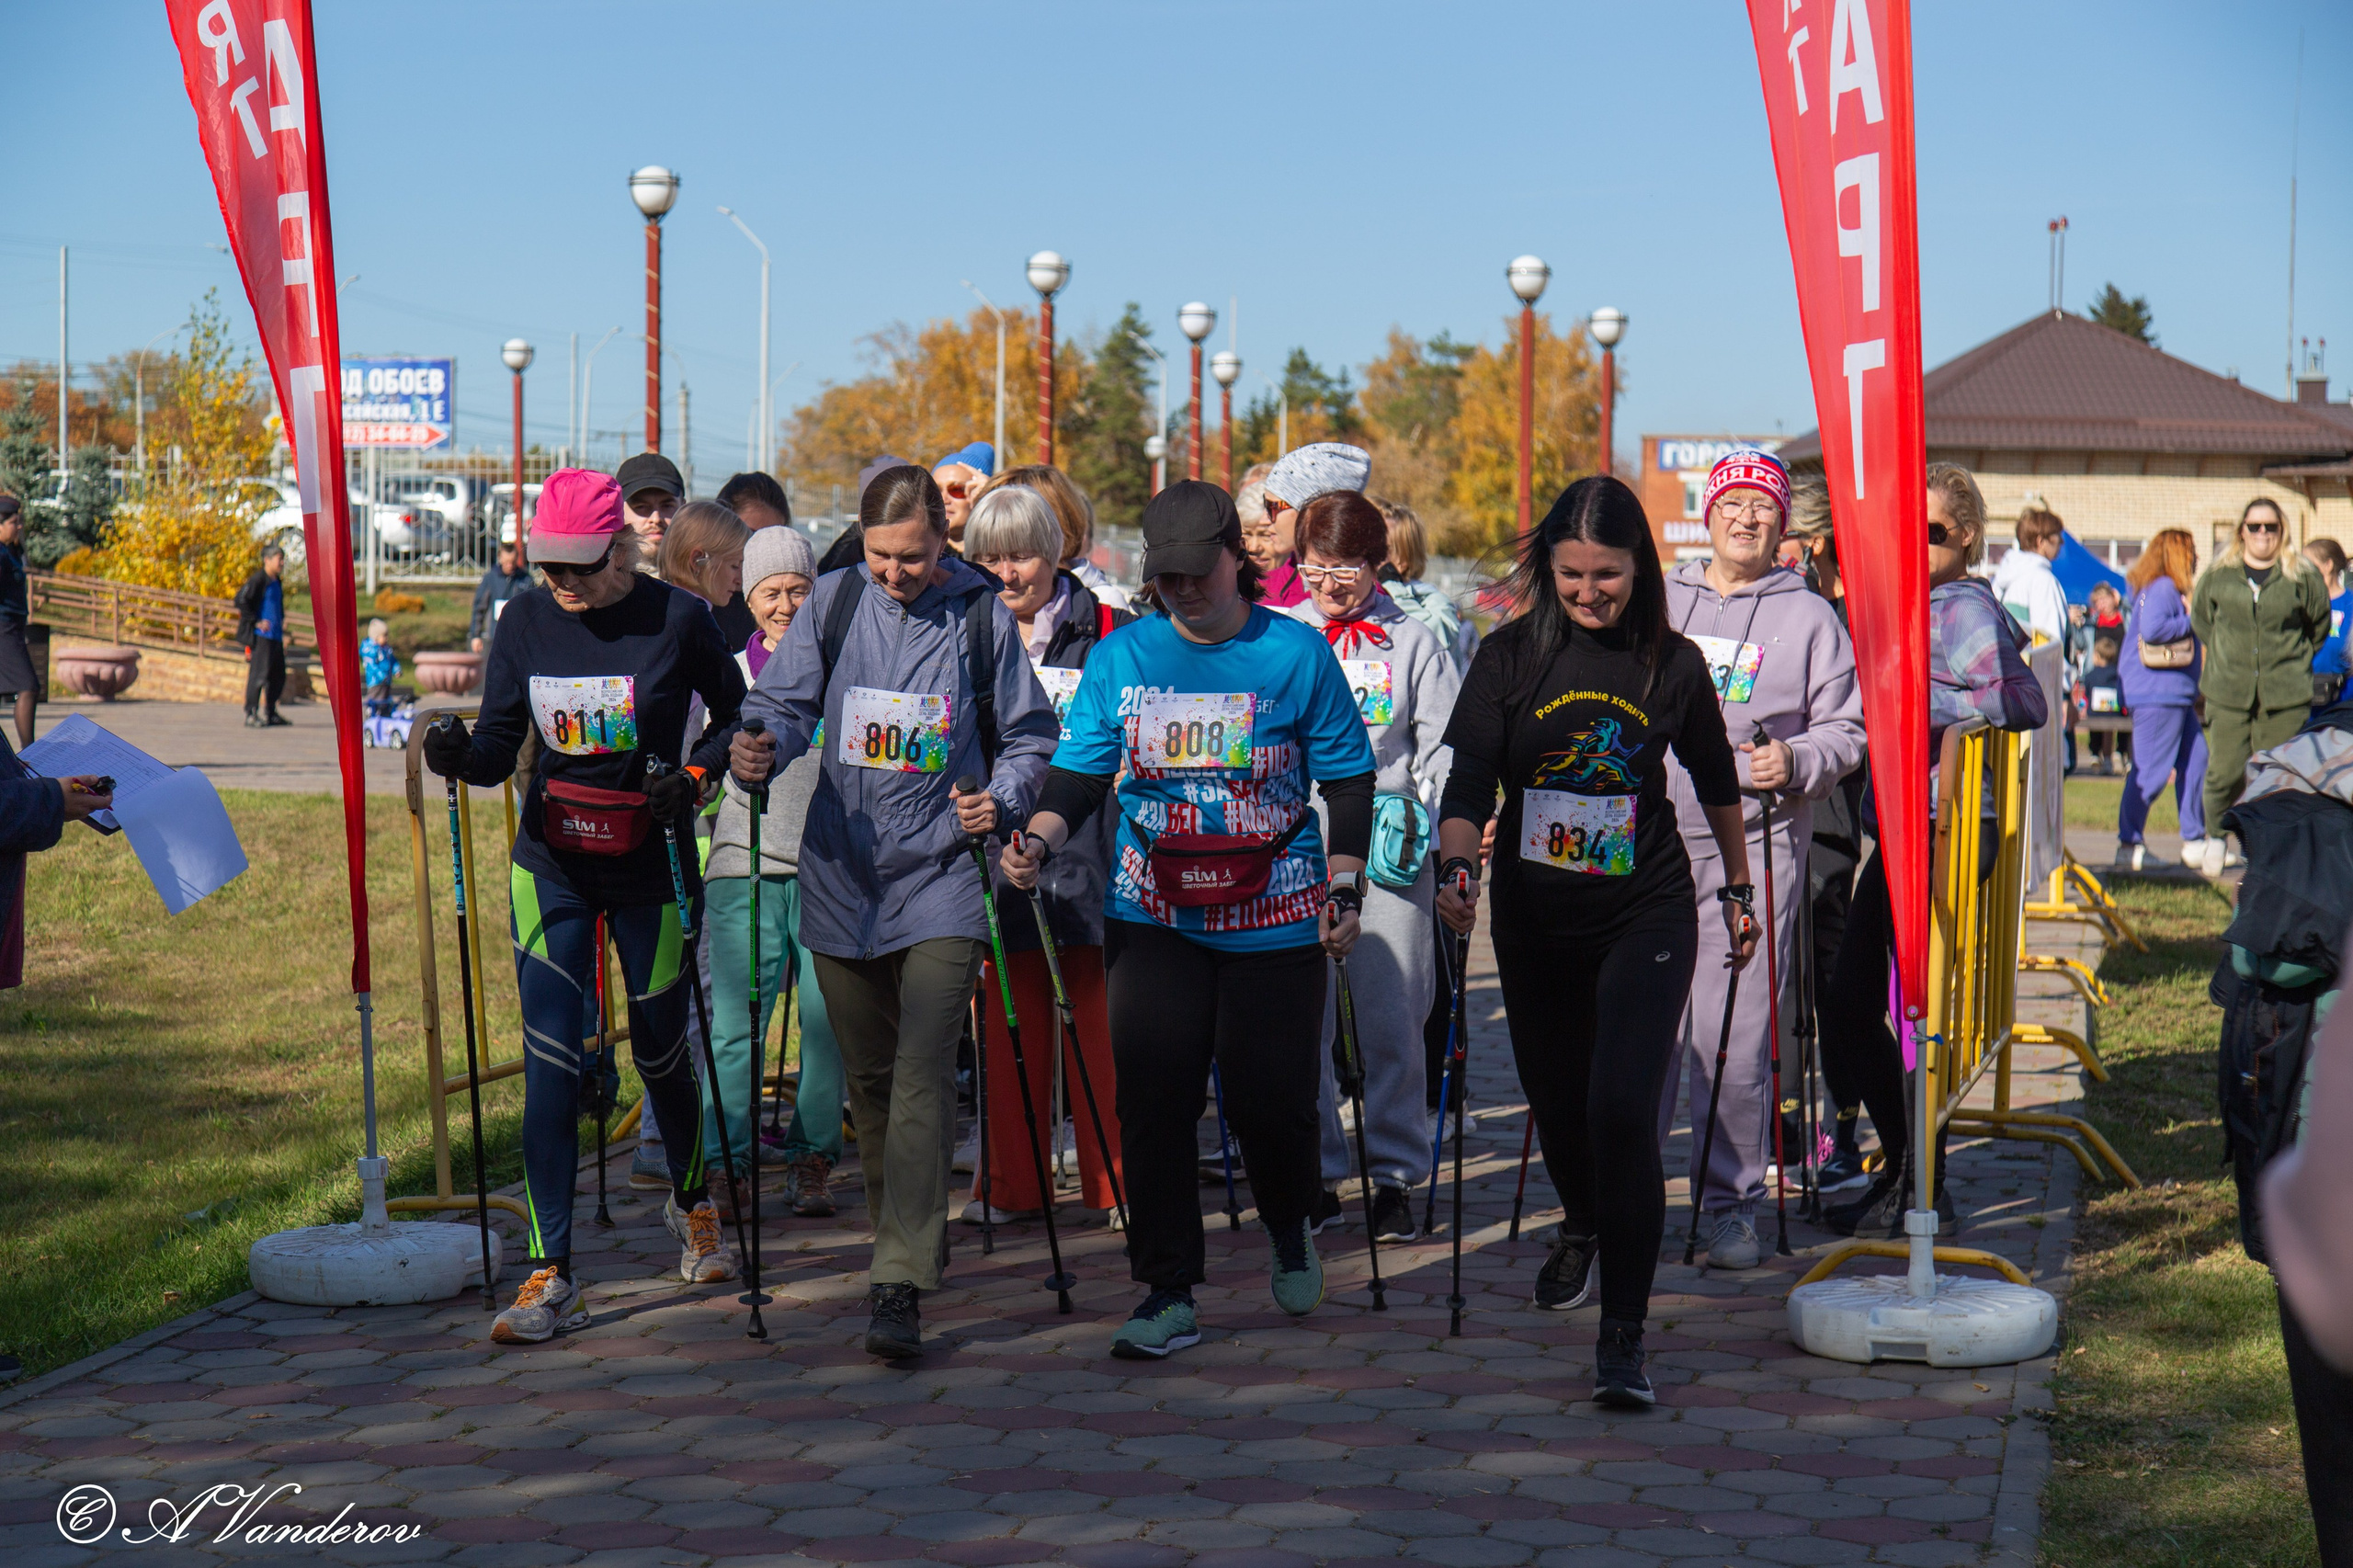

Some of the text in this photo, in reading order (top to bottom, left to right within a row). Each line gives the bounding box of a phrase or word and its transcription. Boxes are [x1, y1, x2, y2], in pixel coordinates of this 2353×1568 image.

[368, 368, 446, 395] ОБОЕВ
[1535, 689, 1651, 727] Рождённые ходить
[553, 709, 608, 745] 811
[865, 722, 922, 763] 806
[1165, 721, 1224, 758] 808
[563, 830, 597, 838] ЦВЕТОЧНЫЙ
[1548, 821, 1607, 865] 834
[1181, 881, 1218, 890] ЦВЕТОЧНЫЙ
